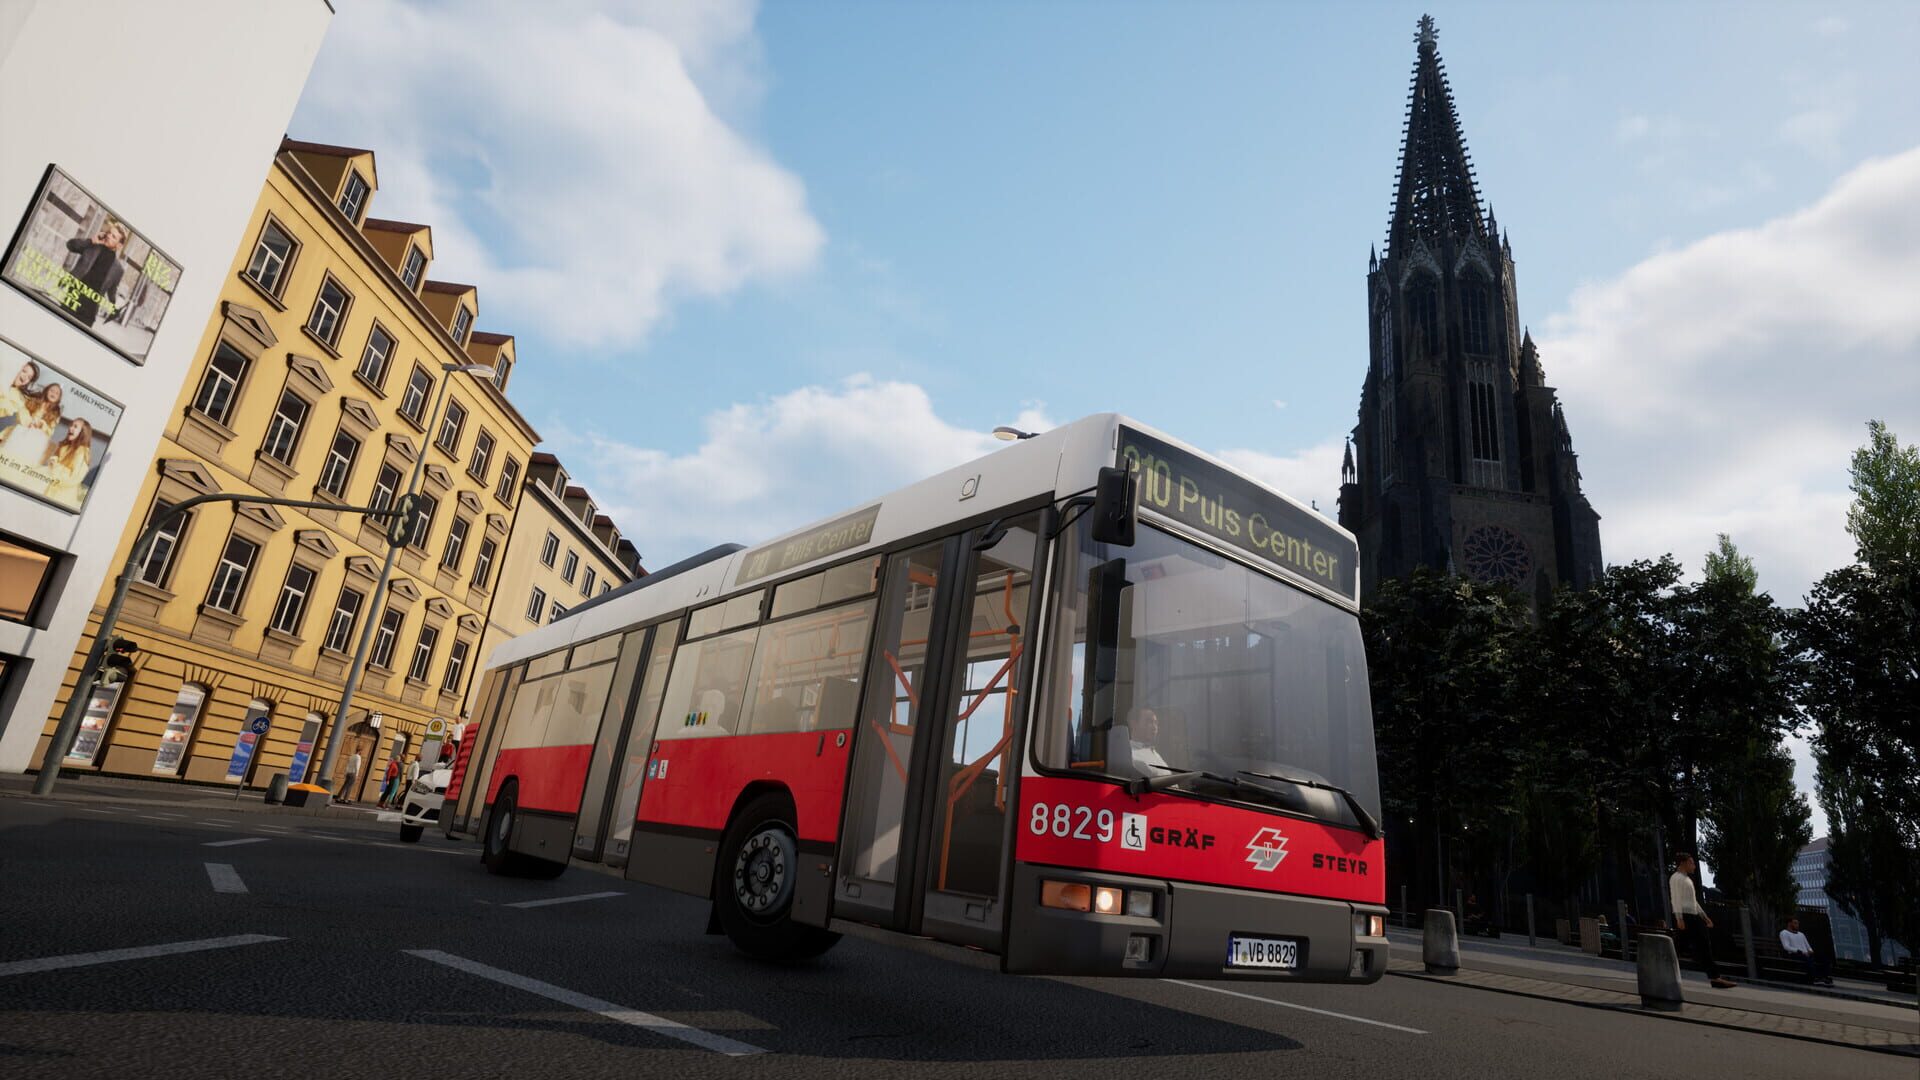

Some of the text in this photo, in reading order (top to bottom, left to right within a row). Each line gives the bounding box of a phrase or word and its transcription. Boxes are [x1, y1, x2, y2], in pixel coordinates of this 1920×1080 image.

[70, 387, 116, 416] FAMILYHOTEL
[817, 521, 871, 551] Center
[1179, 475, 1242, 537] Puls
[1248, 512, 1338, 581] Center
[1030, 802, 1114, 844] 8829
[1150, 828, 1216, 850] GRÄF
[1312, 853, 1369, 876] STEYR
[1233, 941, 1296, 965] T VB 8829
